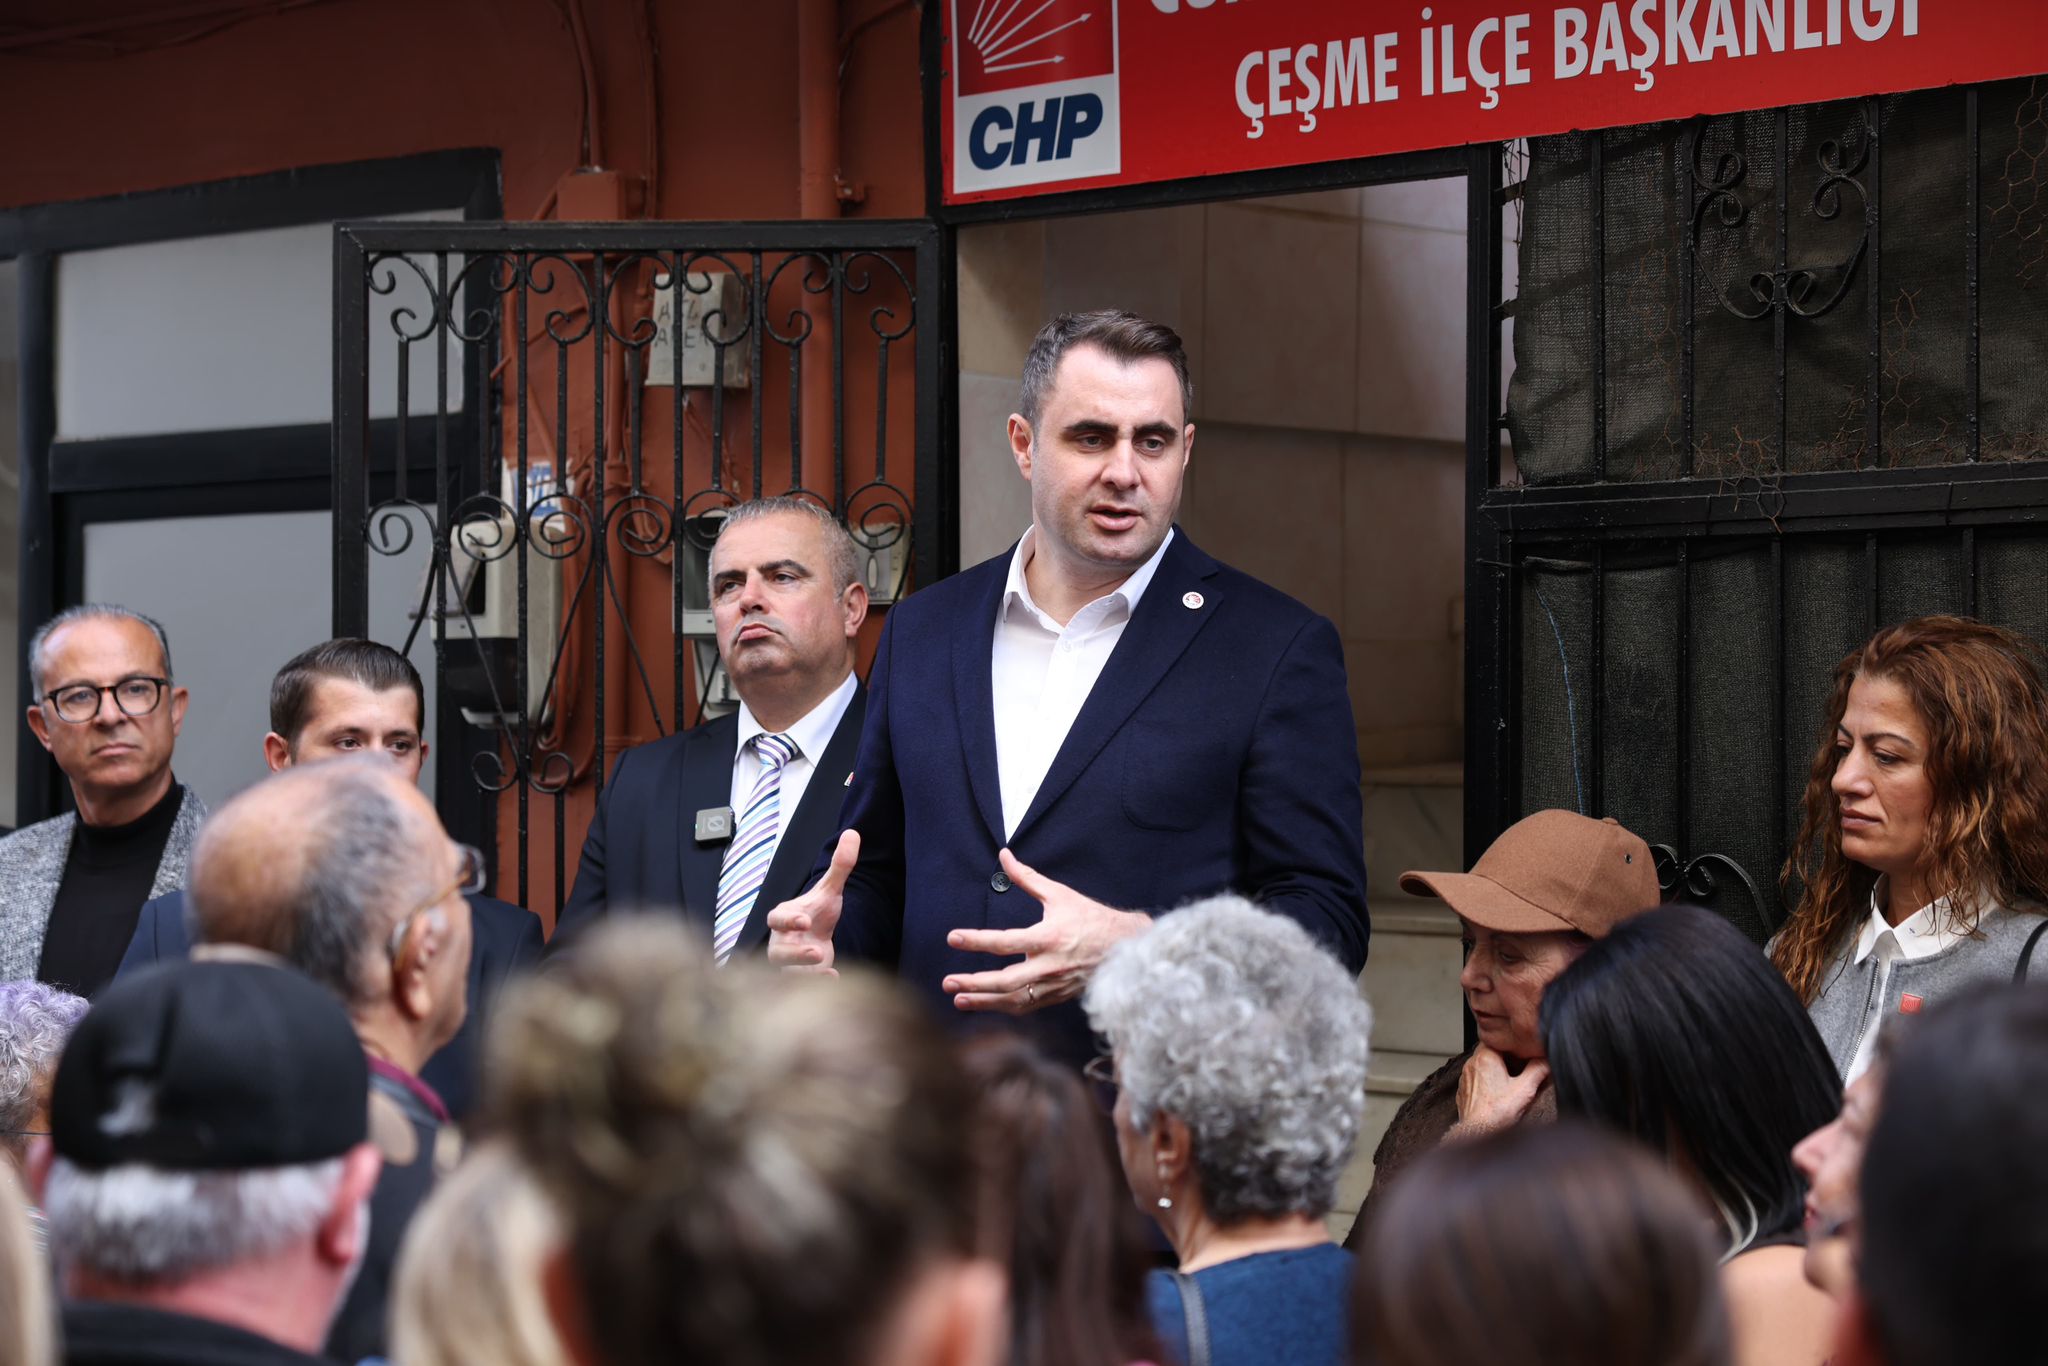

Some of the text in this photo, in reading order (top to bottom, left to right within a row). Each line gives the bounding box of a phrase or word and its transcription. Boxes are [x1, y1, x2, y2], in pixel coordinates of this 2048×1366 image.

[1235, 32, 1399, 139] ÇEŞME
[1420, 7, 1531, 110] İLÇE
[969, 93, 1104, 171] CHP
